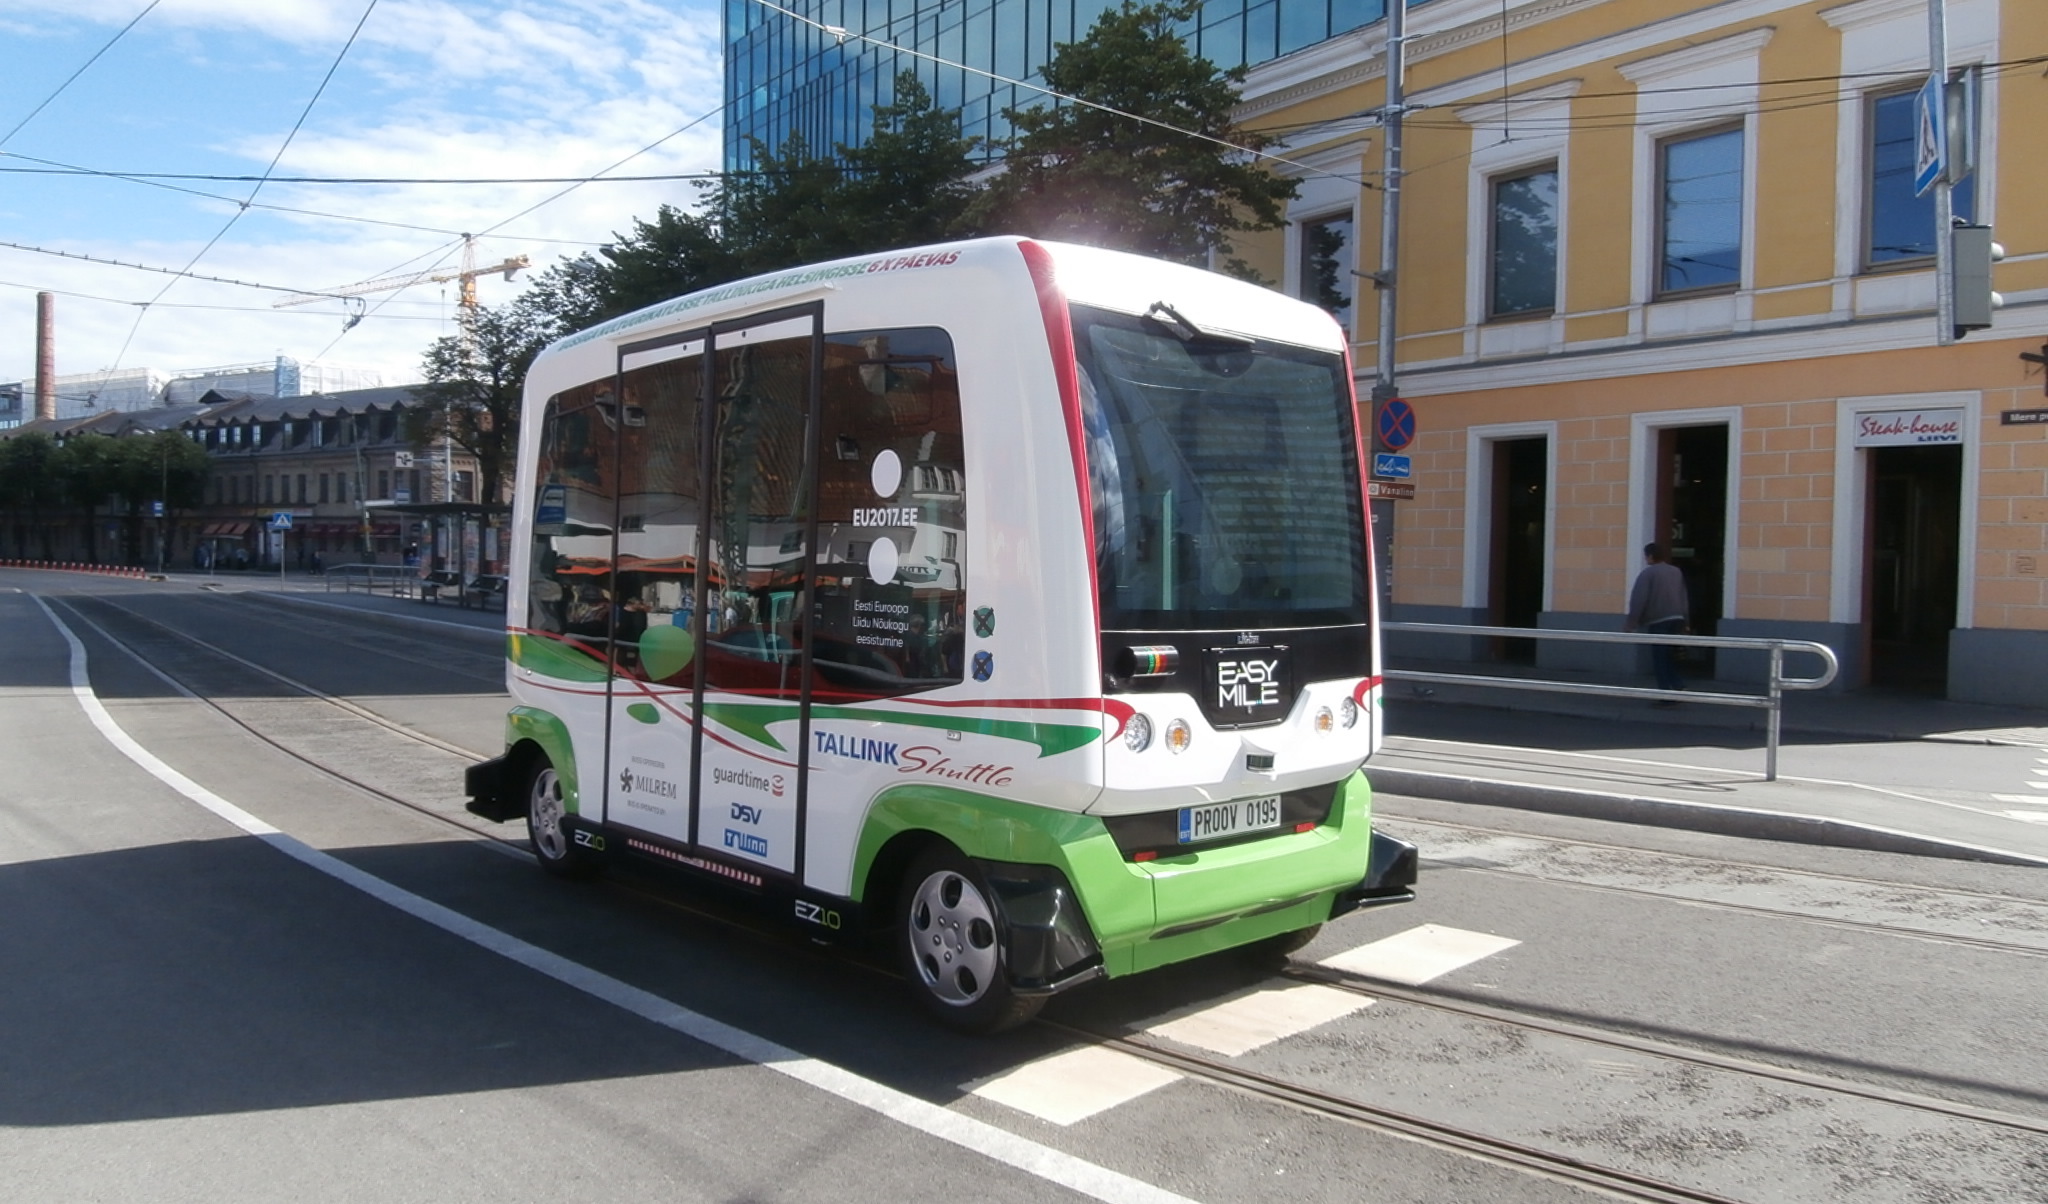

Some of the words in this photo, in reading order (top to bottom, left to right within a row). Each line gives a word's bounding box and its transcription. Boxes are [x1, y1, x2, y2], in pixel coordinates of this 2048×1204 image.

[776, 262, 870, 289] HELSINGISSE
[867, 261, 880, 273] 6
[878, 258, 894, 272] X
[893, 250, 962, 270] PÄEVAS
[1860, 414, 1959, 437] Steak-house
[2009, 413, 2037, 422] Mere
[852, 508, 919, 528] EU2017.EE
[854, 600, 874, 612] Eesti
[874, 601, 909, 615] Euroopa
[852, 616, 872, 629] Liidu
[872, 616, 909, 633] Nõukogu
[856, 634, 904, 648] eesistumine
[1218, 659, 1279, 685] EASY
[1218, 682, 1279, 708] MILE
[814, 731, 899, 766] TALLINK
[898, 745, 1015, 787] Shuttle
[635, 774, 678, 800] MILREM
[712, 765, 770, 792] guardtime
[730, 802, 762, 826] DSV
[1246, 798, 1278, 828] 0195
[574, 829, 606, 851] EZ10
[795, 899, 841, 930] EZ10
